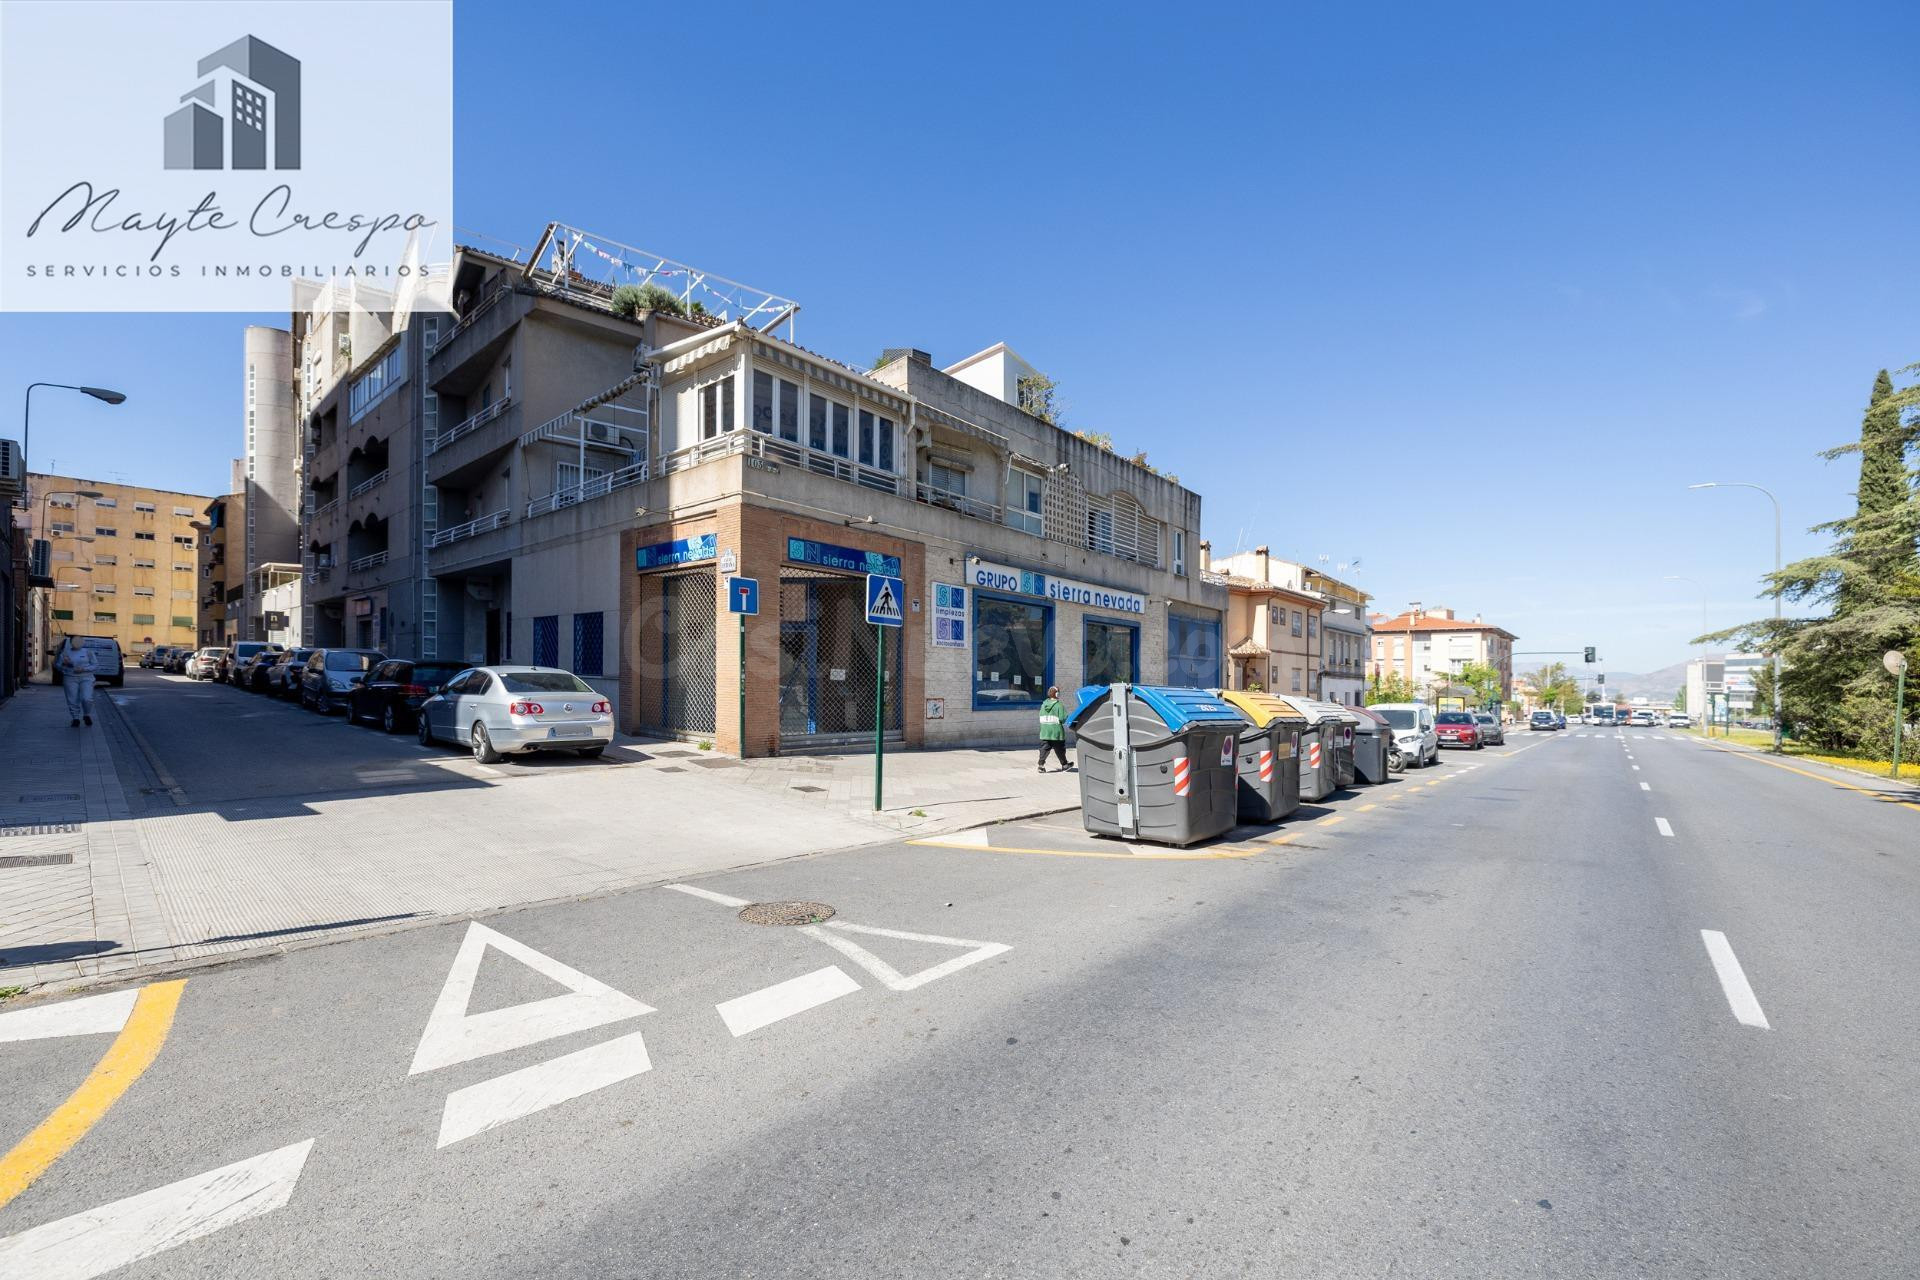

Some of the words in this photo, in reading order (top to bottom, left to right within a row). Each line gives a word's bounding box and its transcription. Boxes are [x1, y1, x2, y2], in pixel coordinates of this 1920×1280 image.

[822, 554, 855, 569] sierra
[976, 570, 1018, 591] GRUPO
[1050, 580, 1091, 604] sierra
[1095, 592, 1141, 612] nevada
[936, 607, 965, 617] limpiezas
